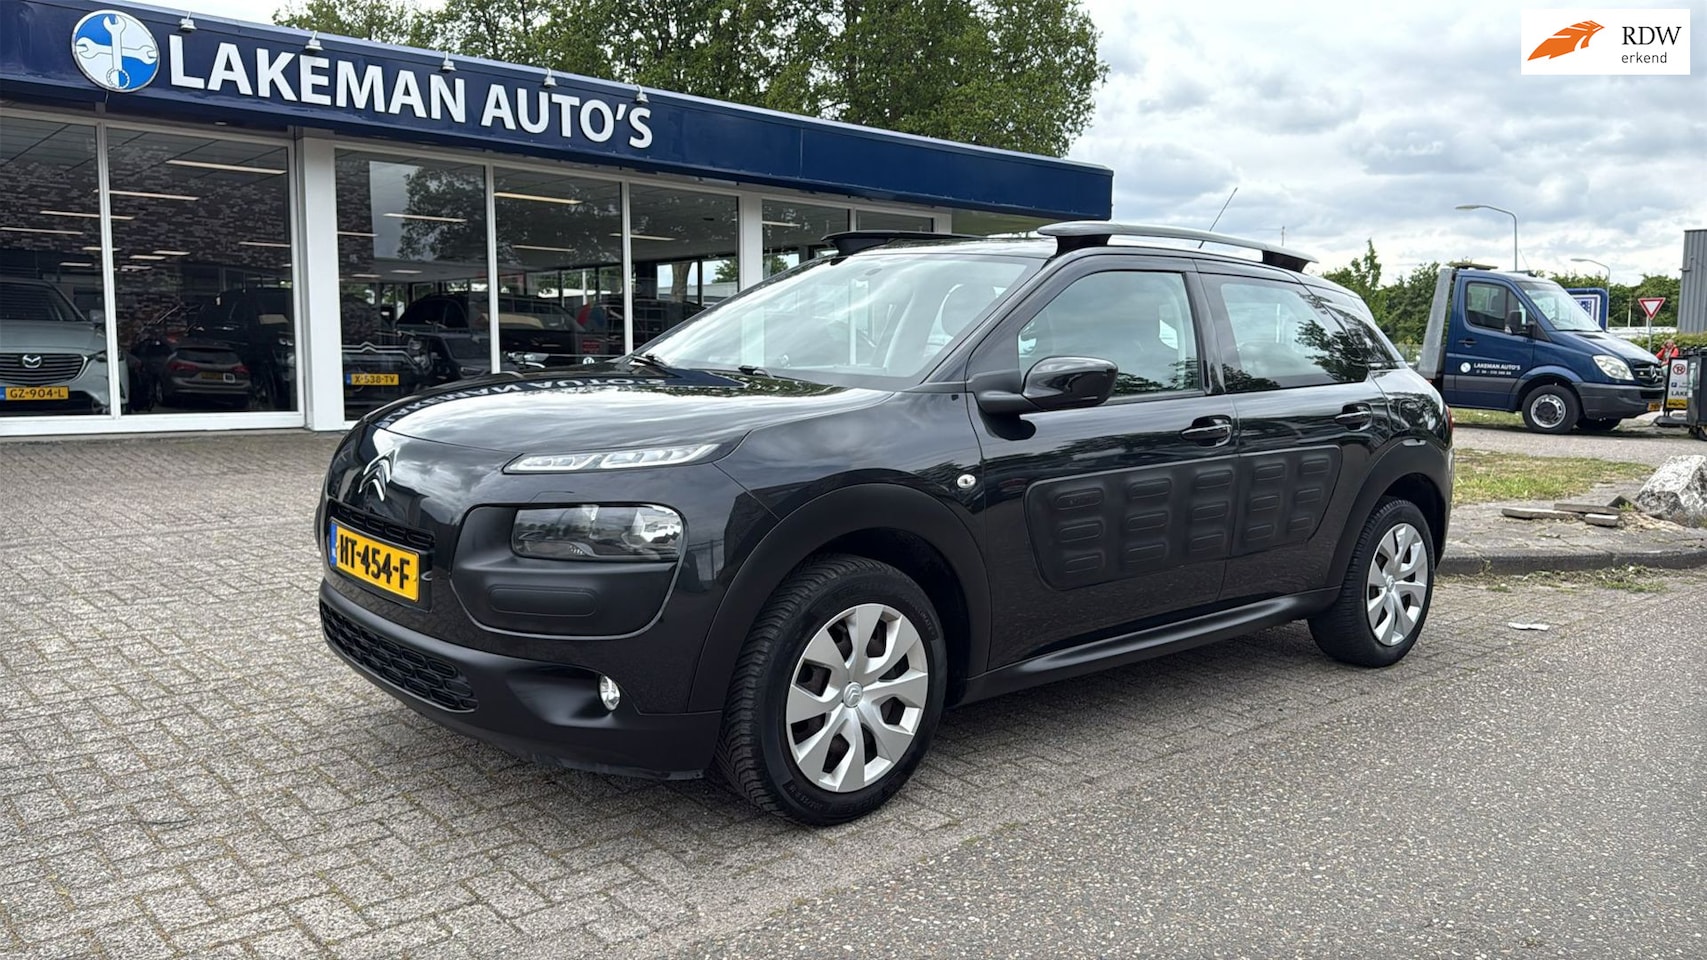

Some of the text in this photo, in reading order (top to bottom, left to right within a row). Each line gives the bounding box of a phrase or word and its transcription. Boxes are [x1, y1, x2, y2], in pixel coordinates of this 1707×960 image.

[169, 35, 653, 149] LAKEMAN AUTO'S
[1473, 362, 1501, 370] LAKEMAN
[10, 388, 65, 399] GZ-904-L
[340, 533, 411, 590] HT-454-F
